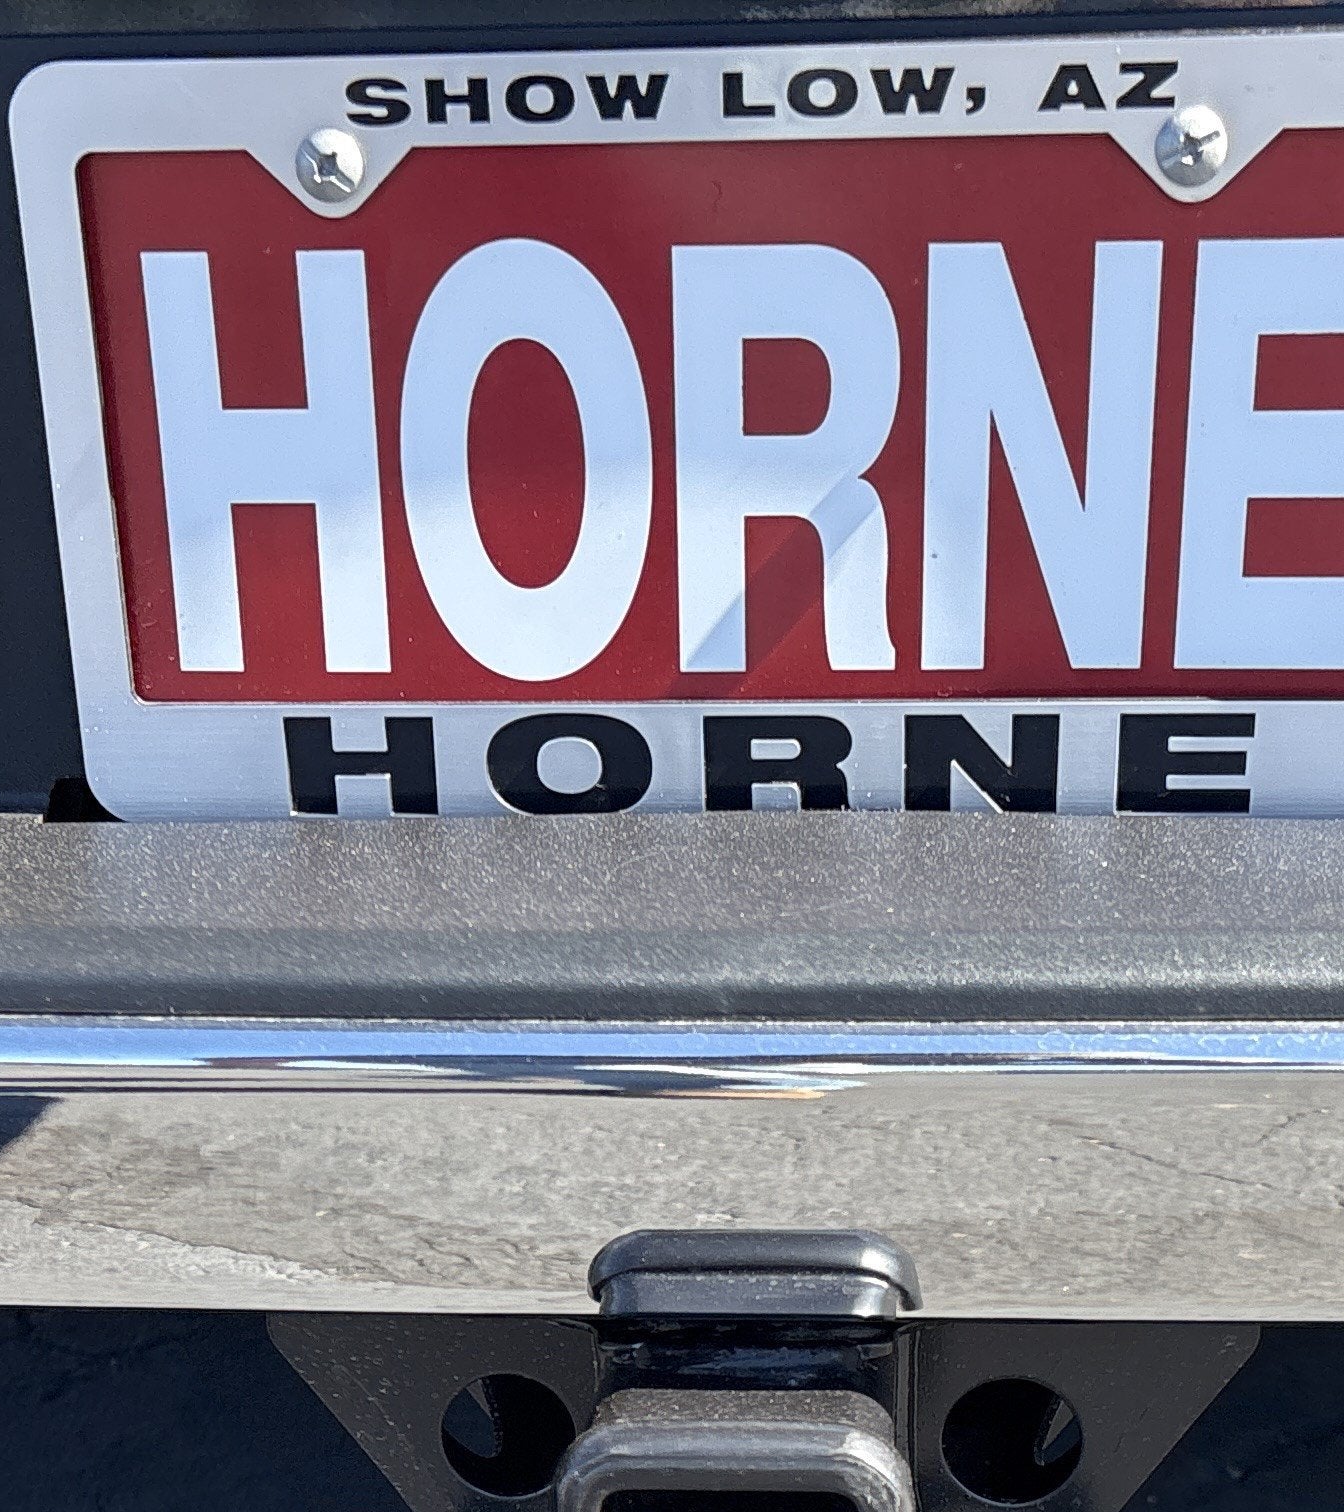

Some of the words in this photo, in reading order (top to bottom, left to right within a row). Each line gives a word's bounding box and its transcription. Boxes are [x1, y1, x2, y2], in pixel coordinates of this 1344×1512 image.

[344, 73, 668, 126] SHOW
[721, 67, 988, 117] LOW,
[1038, 61, 1179, 111] AZ
[283, 713, 1257, 815] HORNE
